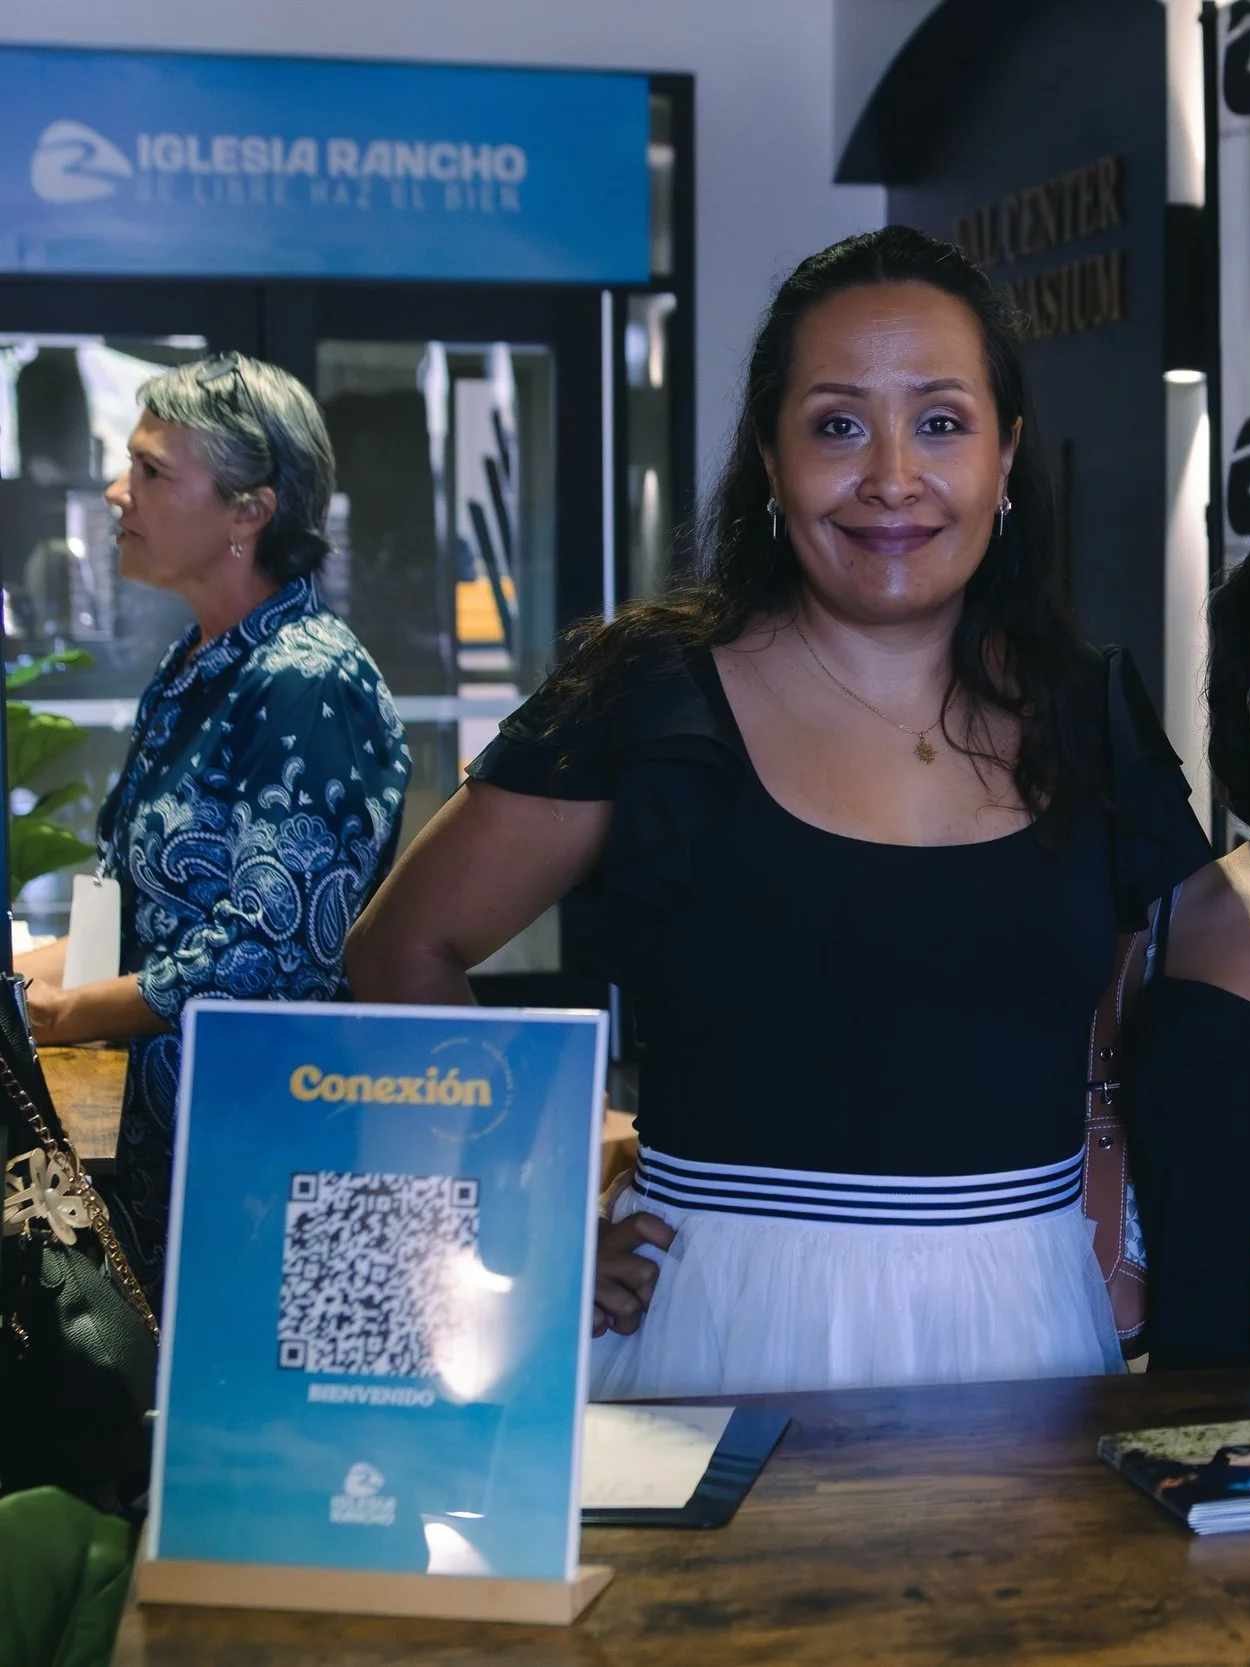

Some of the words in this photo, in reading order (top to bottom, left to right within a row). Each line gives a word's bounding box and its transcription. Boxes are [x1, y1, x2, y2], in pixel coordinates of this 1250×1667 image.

[137, 133, 319, 177] IGLESIA
[326, 137, 528, 183] RANCHO
[289, 1064, 494, 1108] Conexión
